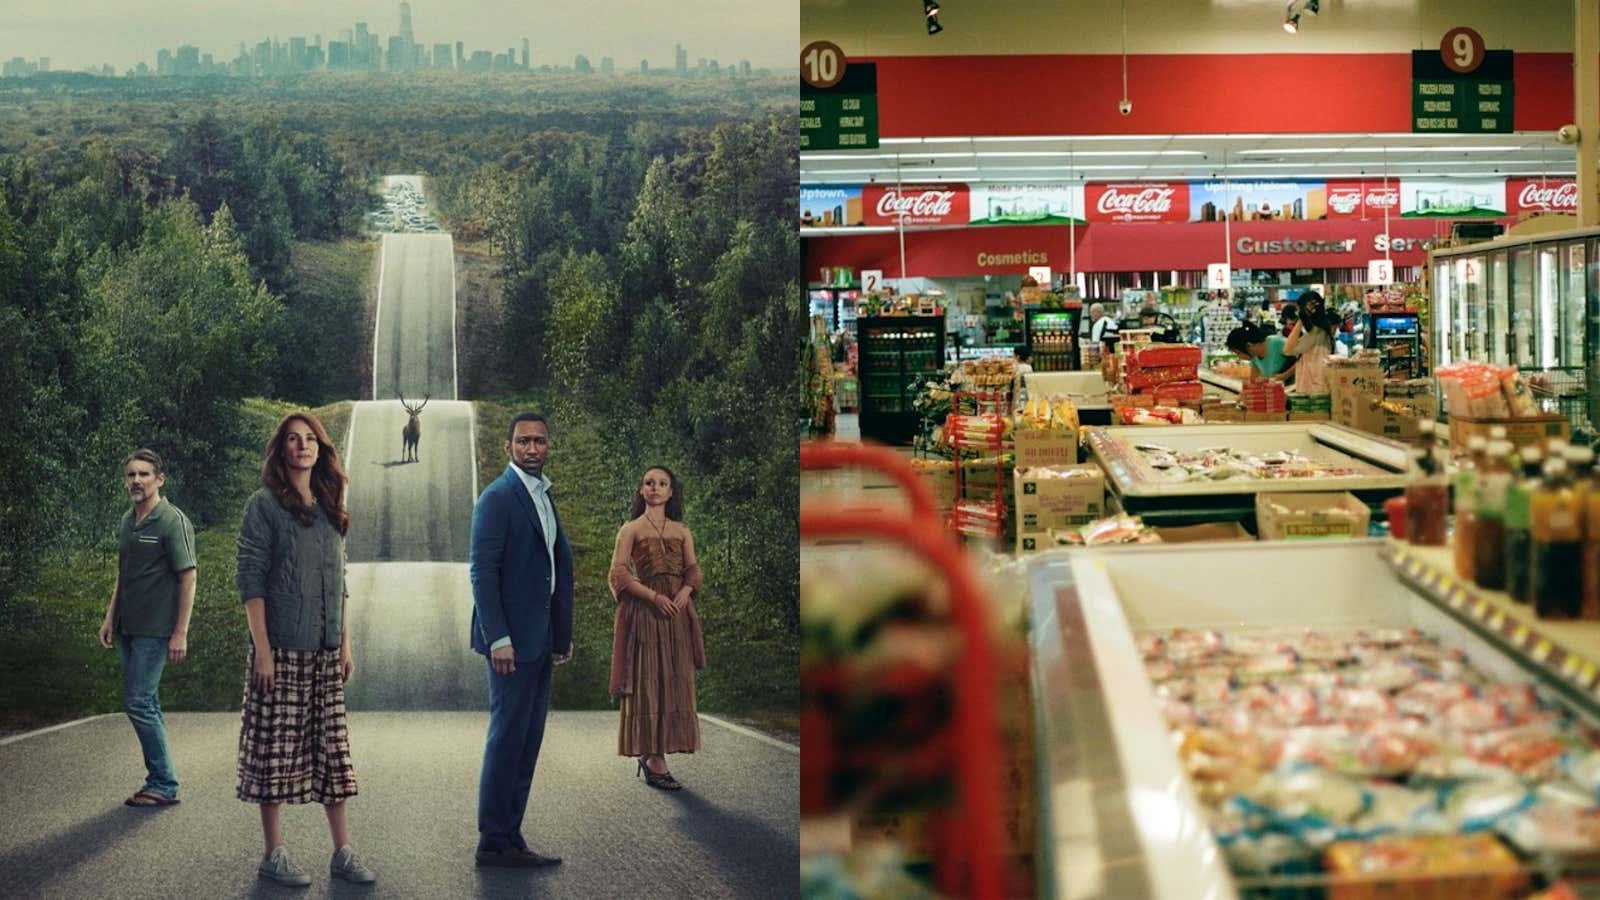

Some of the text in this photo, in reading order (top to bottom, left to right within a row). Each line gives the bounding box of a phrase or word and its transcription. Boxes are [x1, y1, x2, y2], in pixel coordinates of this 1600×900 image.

[1453, 33, 1473, 67] 9
[804, 49, 838, 81] 10
[876, 191, 956, 217] Coca-Cola
[1097, 188, 1175, 214] Coca-Cola
[1236, 236, 1356, 254] Customer
[977, 250, 1048, 267] Cosmetics
[1215, 269, 1224, 284] 4
[1379, 265, 1387, 281] 5
